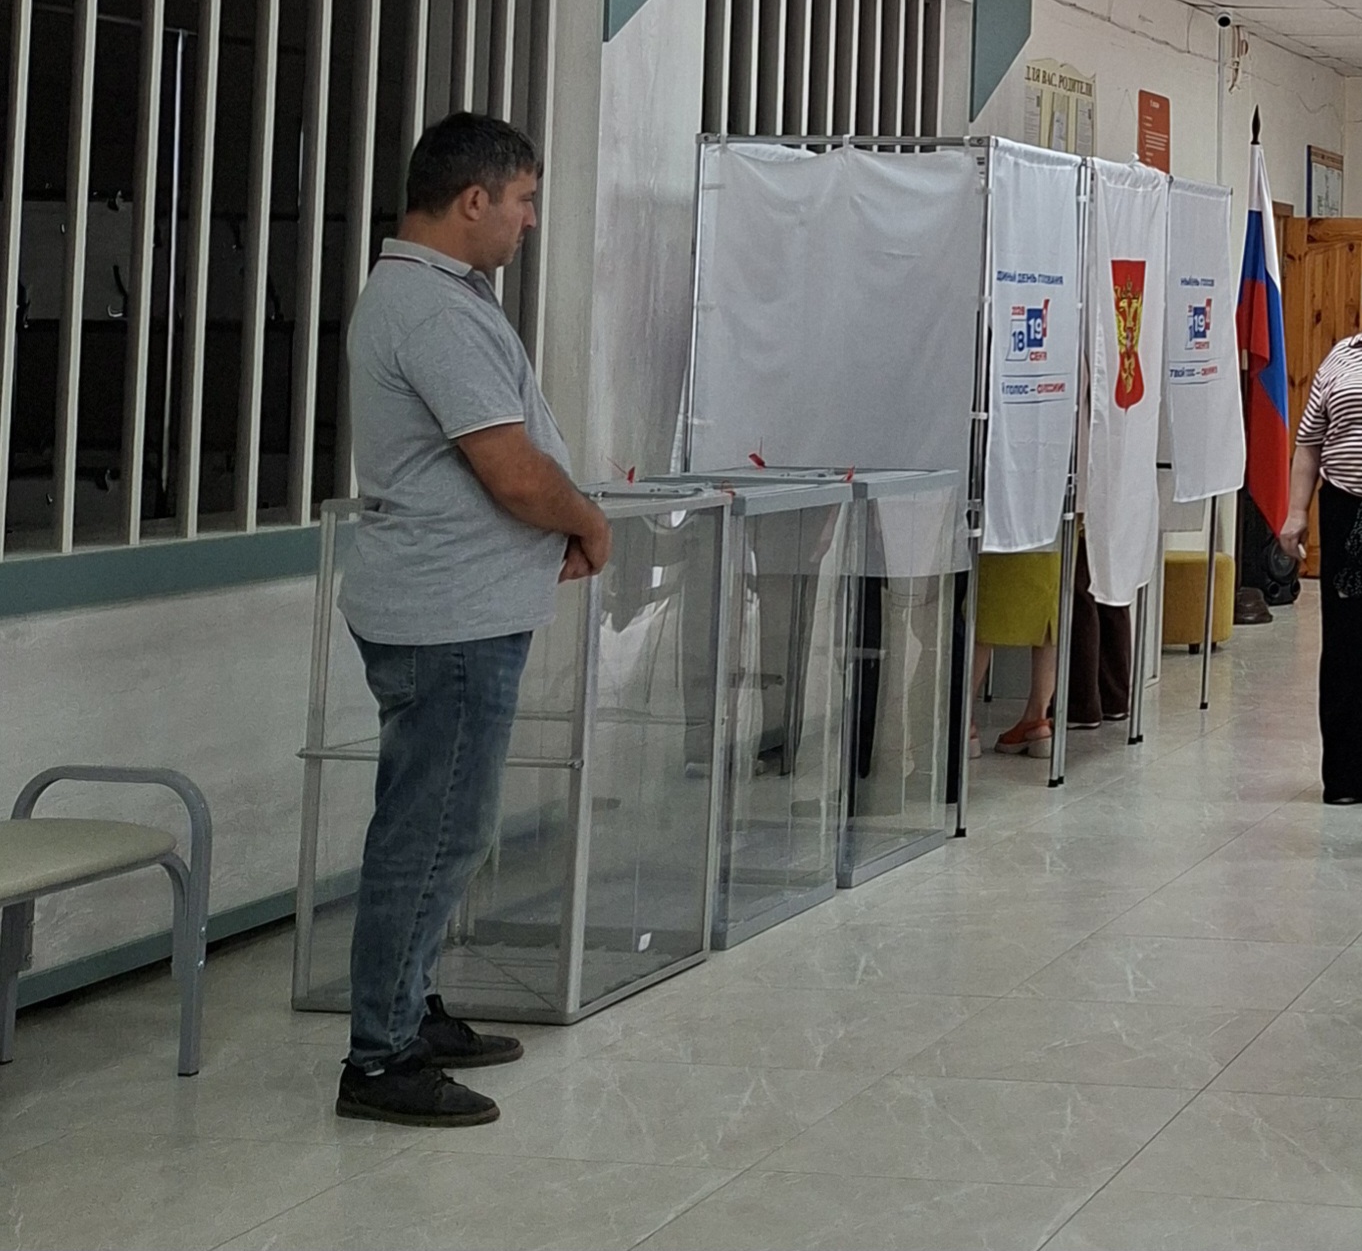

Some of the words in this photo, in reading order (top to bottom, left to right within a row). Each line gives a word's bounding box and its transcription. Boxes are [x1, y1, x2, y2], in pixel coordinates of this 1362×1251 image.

[1024, 64, 1041, 83] ДЛЯ
[1028, 317, 1043, 339] 19
[1193, 314, 1205, 332] 19
[1011, 330, 1025, 352] 18
